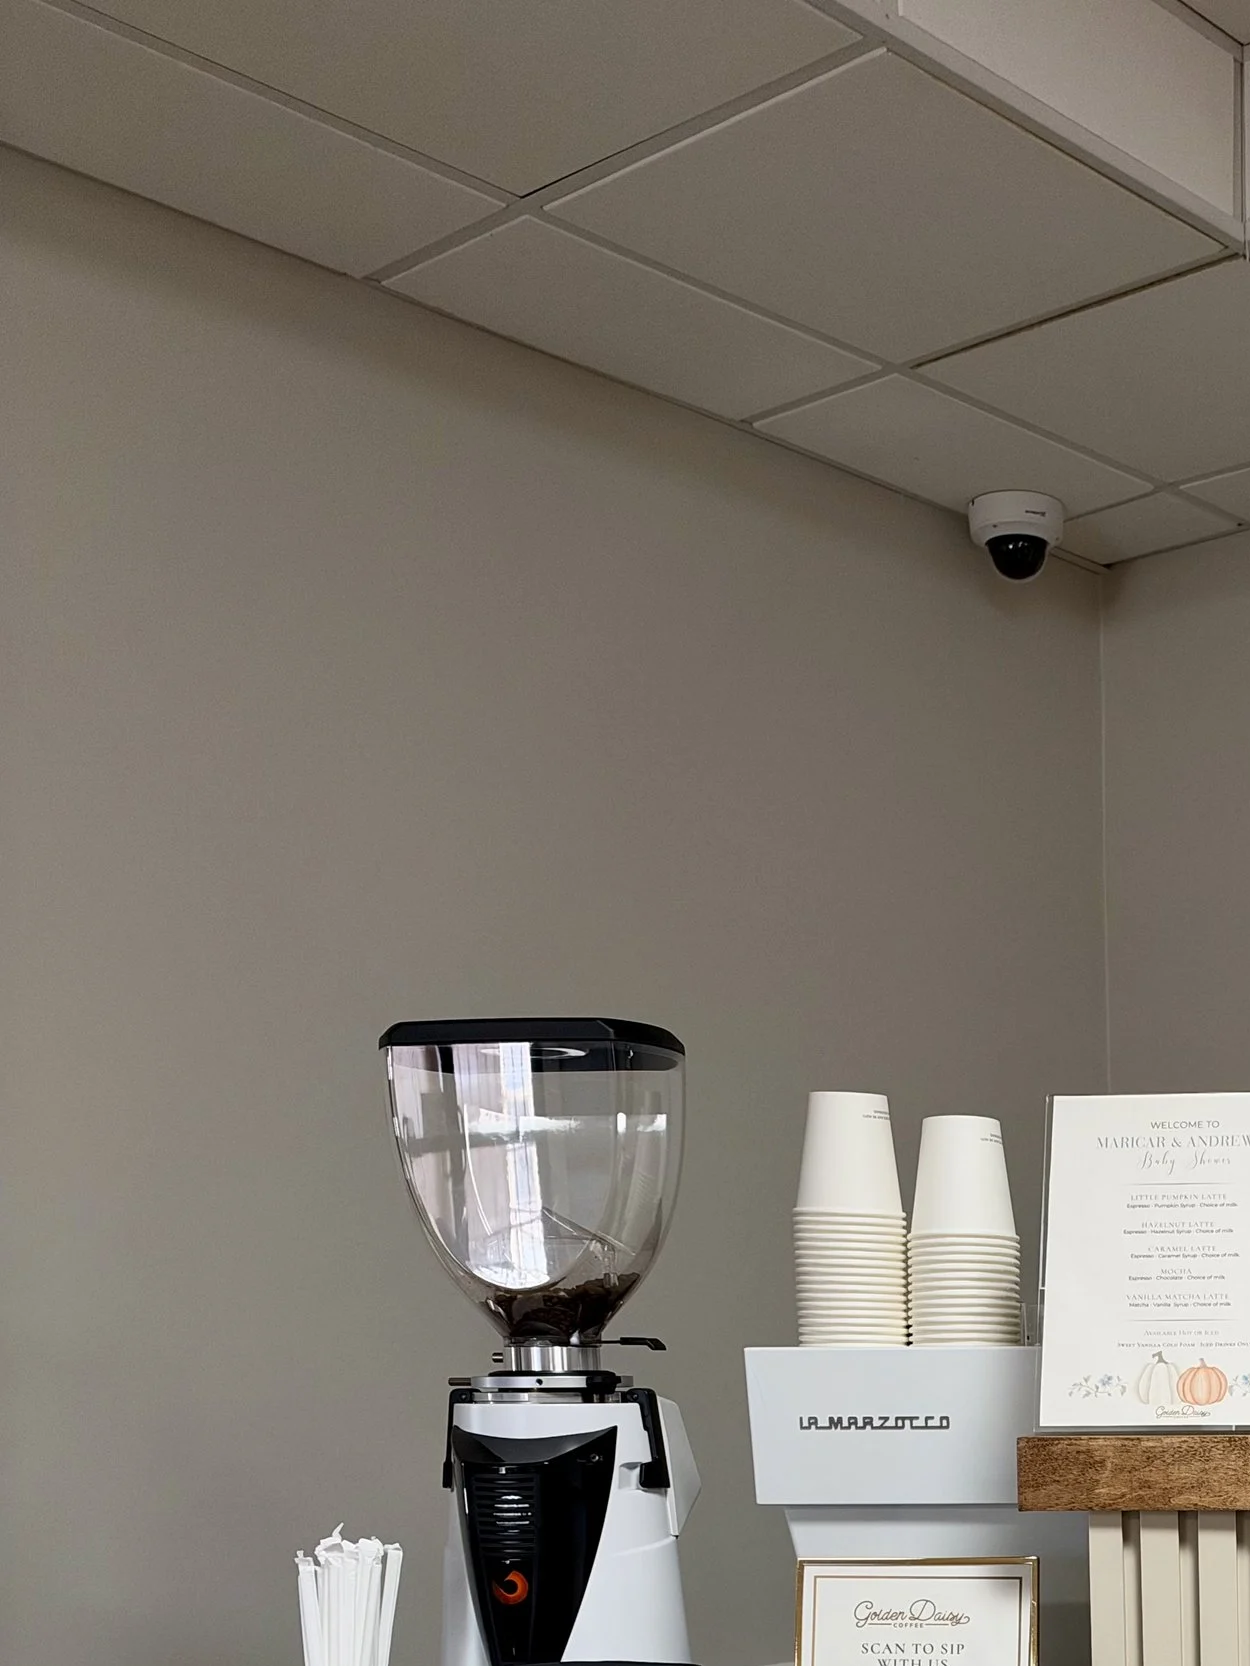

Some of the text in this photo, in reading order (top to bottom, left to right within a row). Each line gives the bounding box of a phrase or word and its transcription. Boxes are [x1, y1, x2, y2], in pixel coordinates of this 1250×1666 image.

[1151, 1120, 1220, 1130] WELCOME TO
[1096, 1136, 1166, 1149] MARICAR
[1171, 1137, 1182, 1148] &
[1139, 1150, 1231, 1176] Baby Shower
[800, 1416, 818, 1431] LA
[854, 1599, 971, 1629] Golden Daisy
[861, 1643, 965, 1655] SCAN TO SIP
